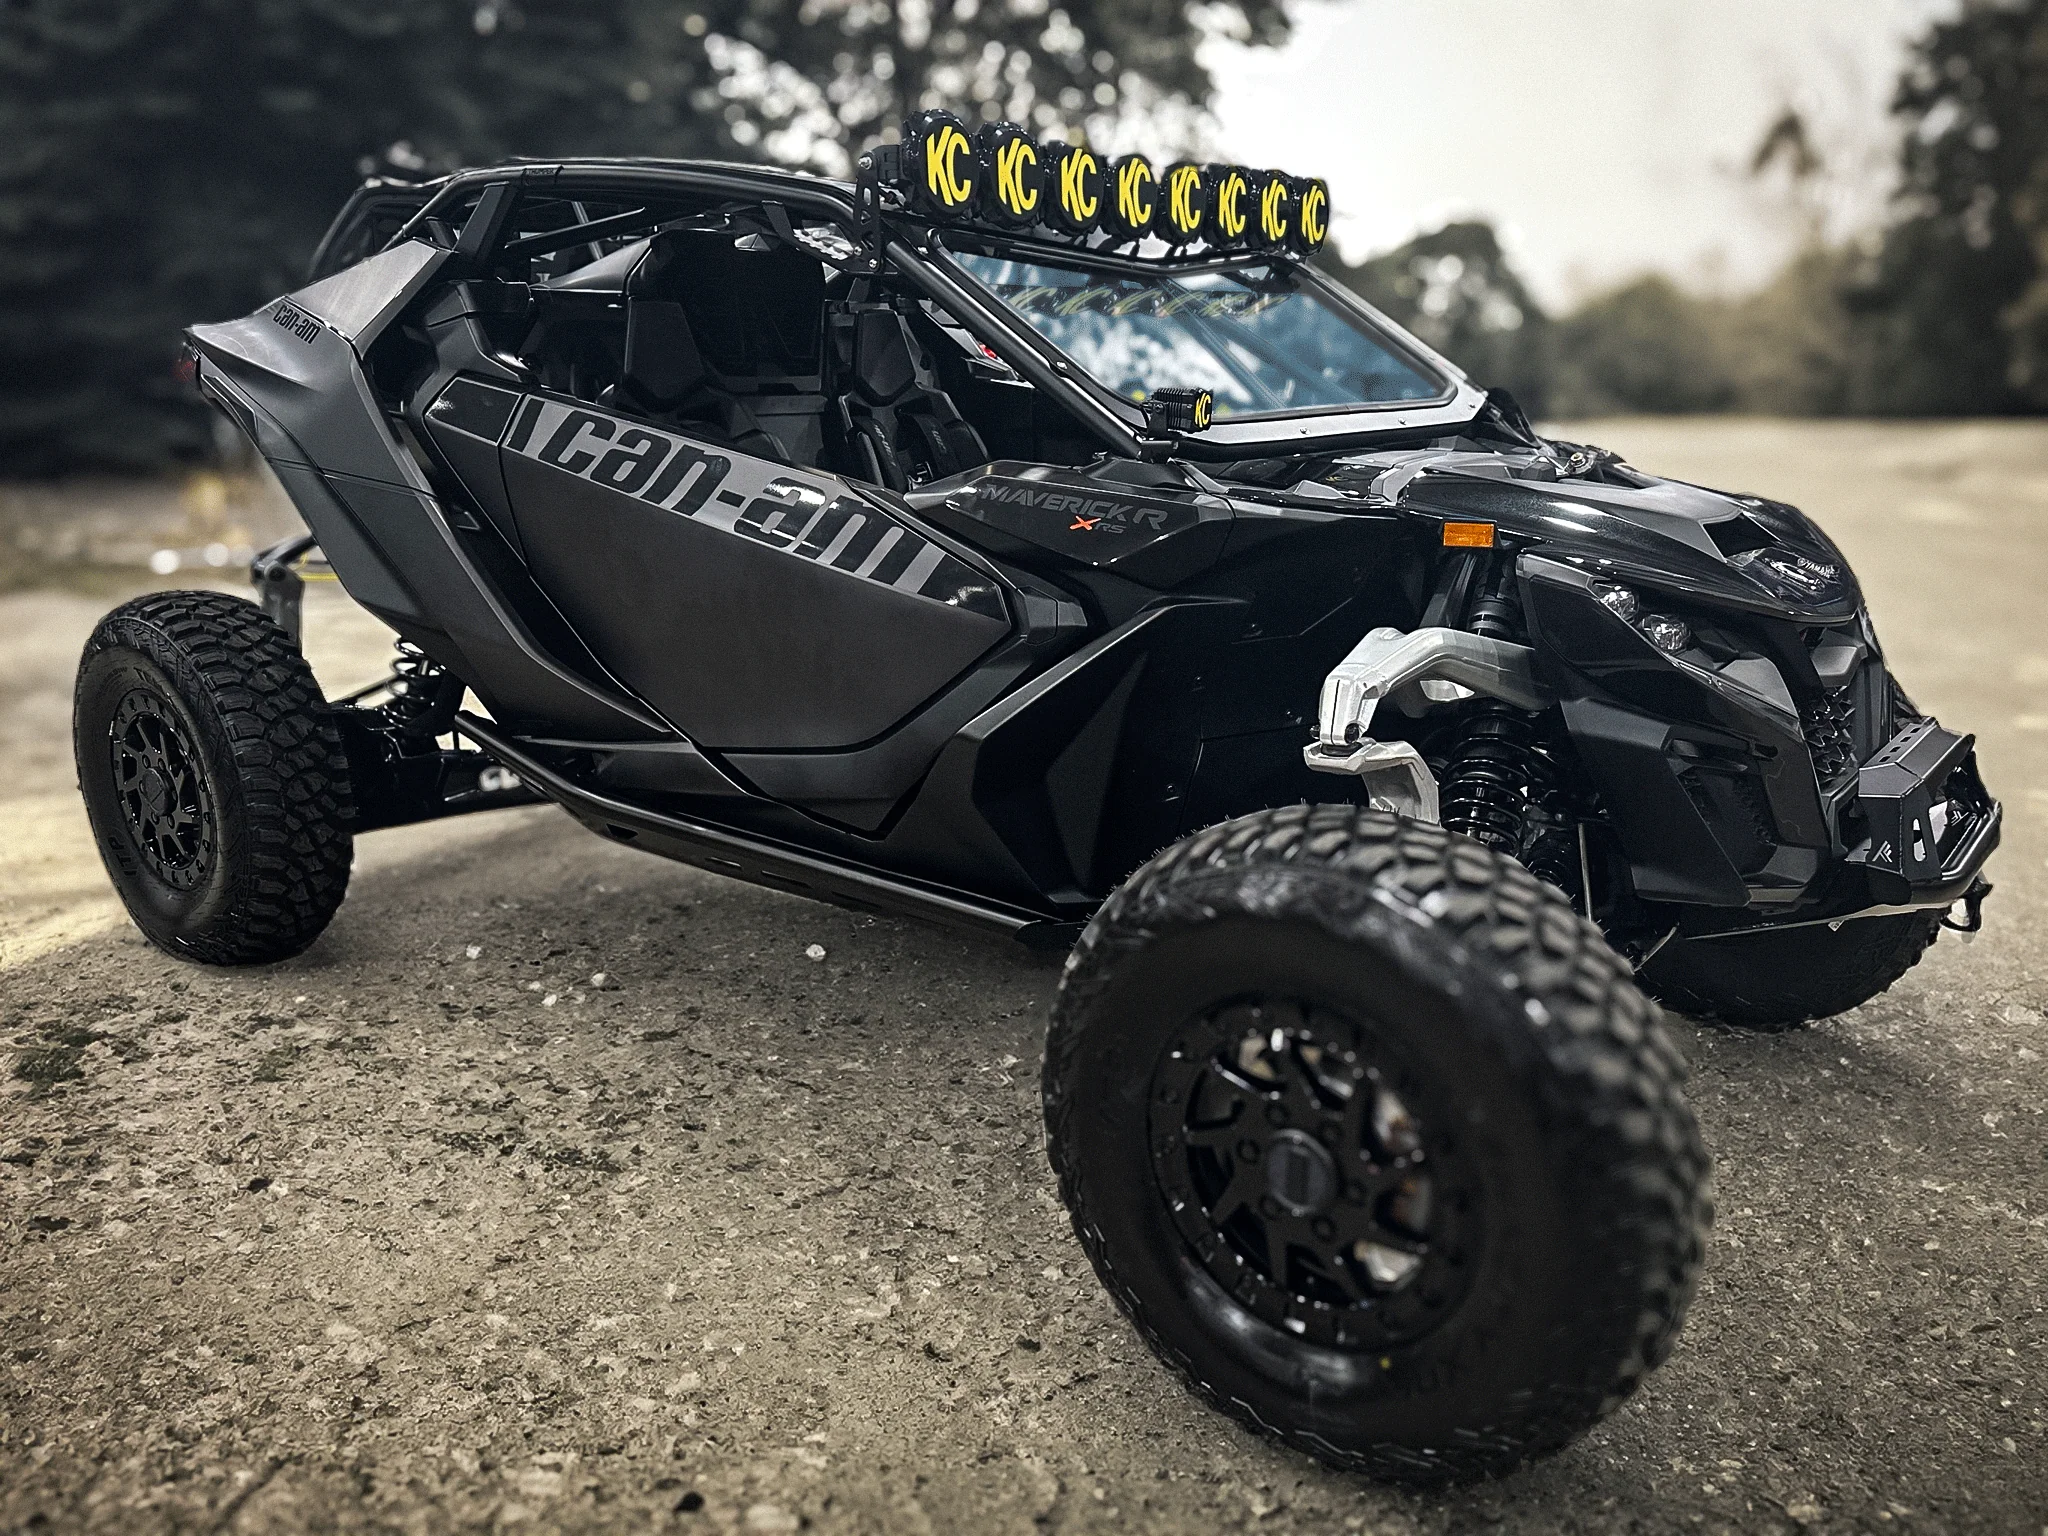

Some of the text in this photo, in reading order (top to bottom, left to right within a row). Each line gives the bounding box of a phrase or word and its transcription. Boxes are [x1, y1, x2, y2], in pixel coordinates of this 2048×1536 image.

[926, 125, 971, 206] KC
[997, 137, 1037, 215] KC
[1061, 148, 1098, 222] KC
[1118, 157, 1152, 228] KC
[1171, 165, 1202, 233] KC
[1218, 172, 1246, 237] KC
[1261, 178, 1287, 242] KC
[1301, 184, 1325, 245] KC
[273, 304, 321, 344] can-am
[1194, 391, 1212, 428] KC
[537, 408, 930, 586] can-am
[981, 483, 1168, 530] MAVERICK R
